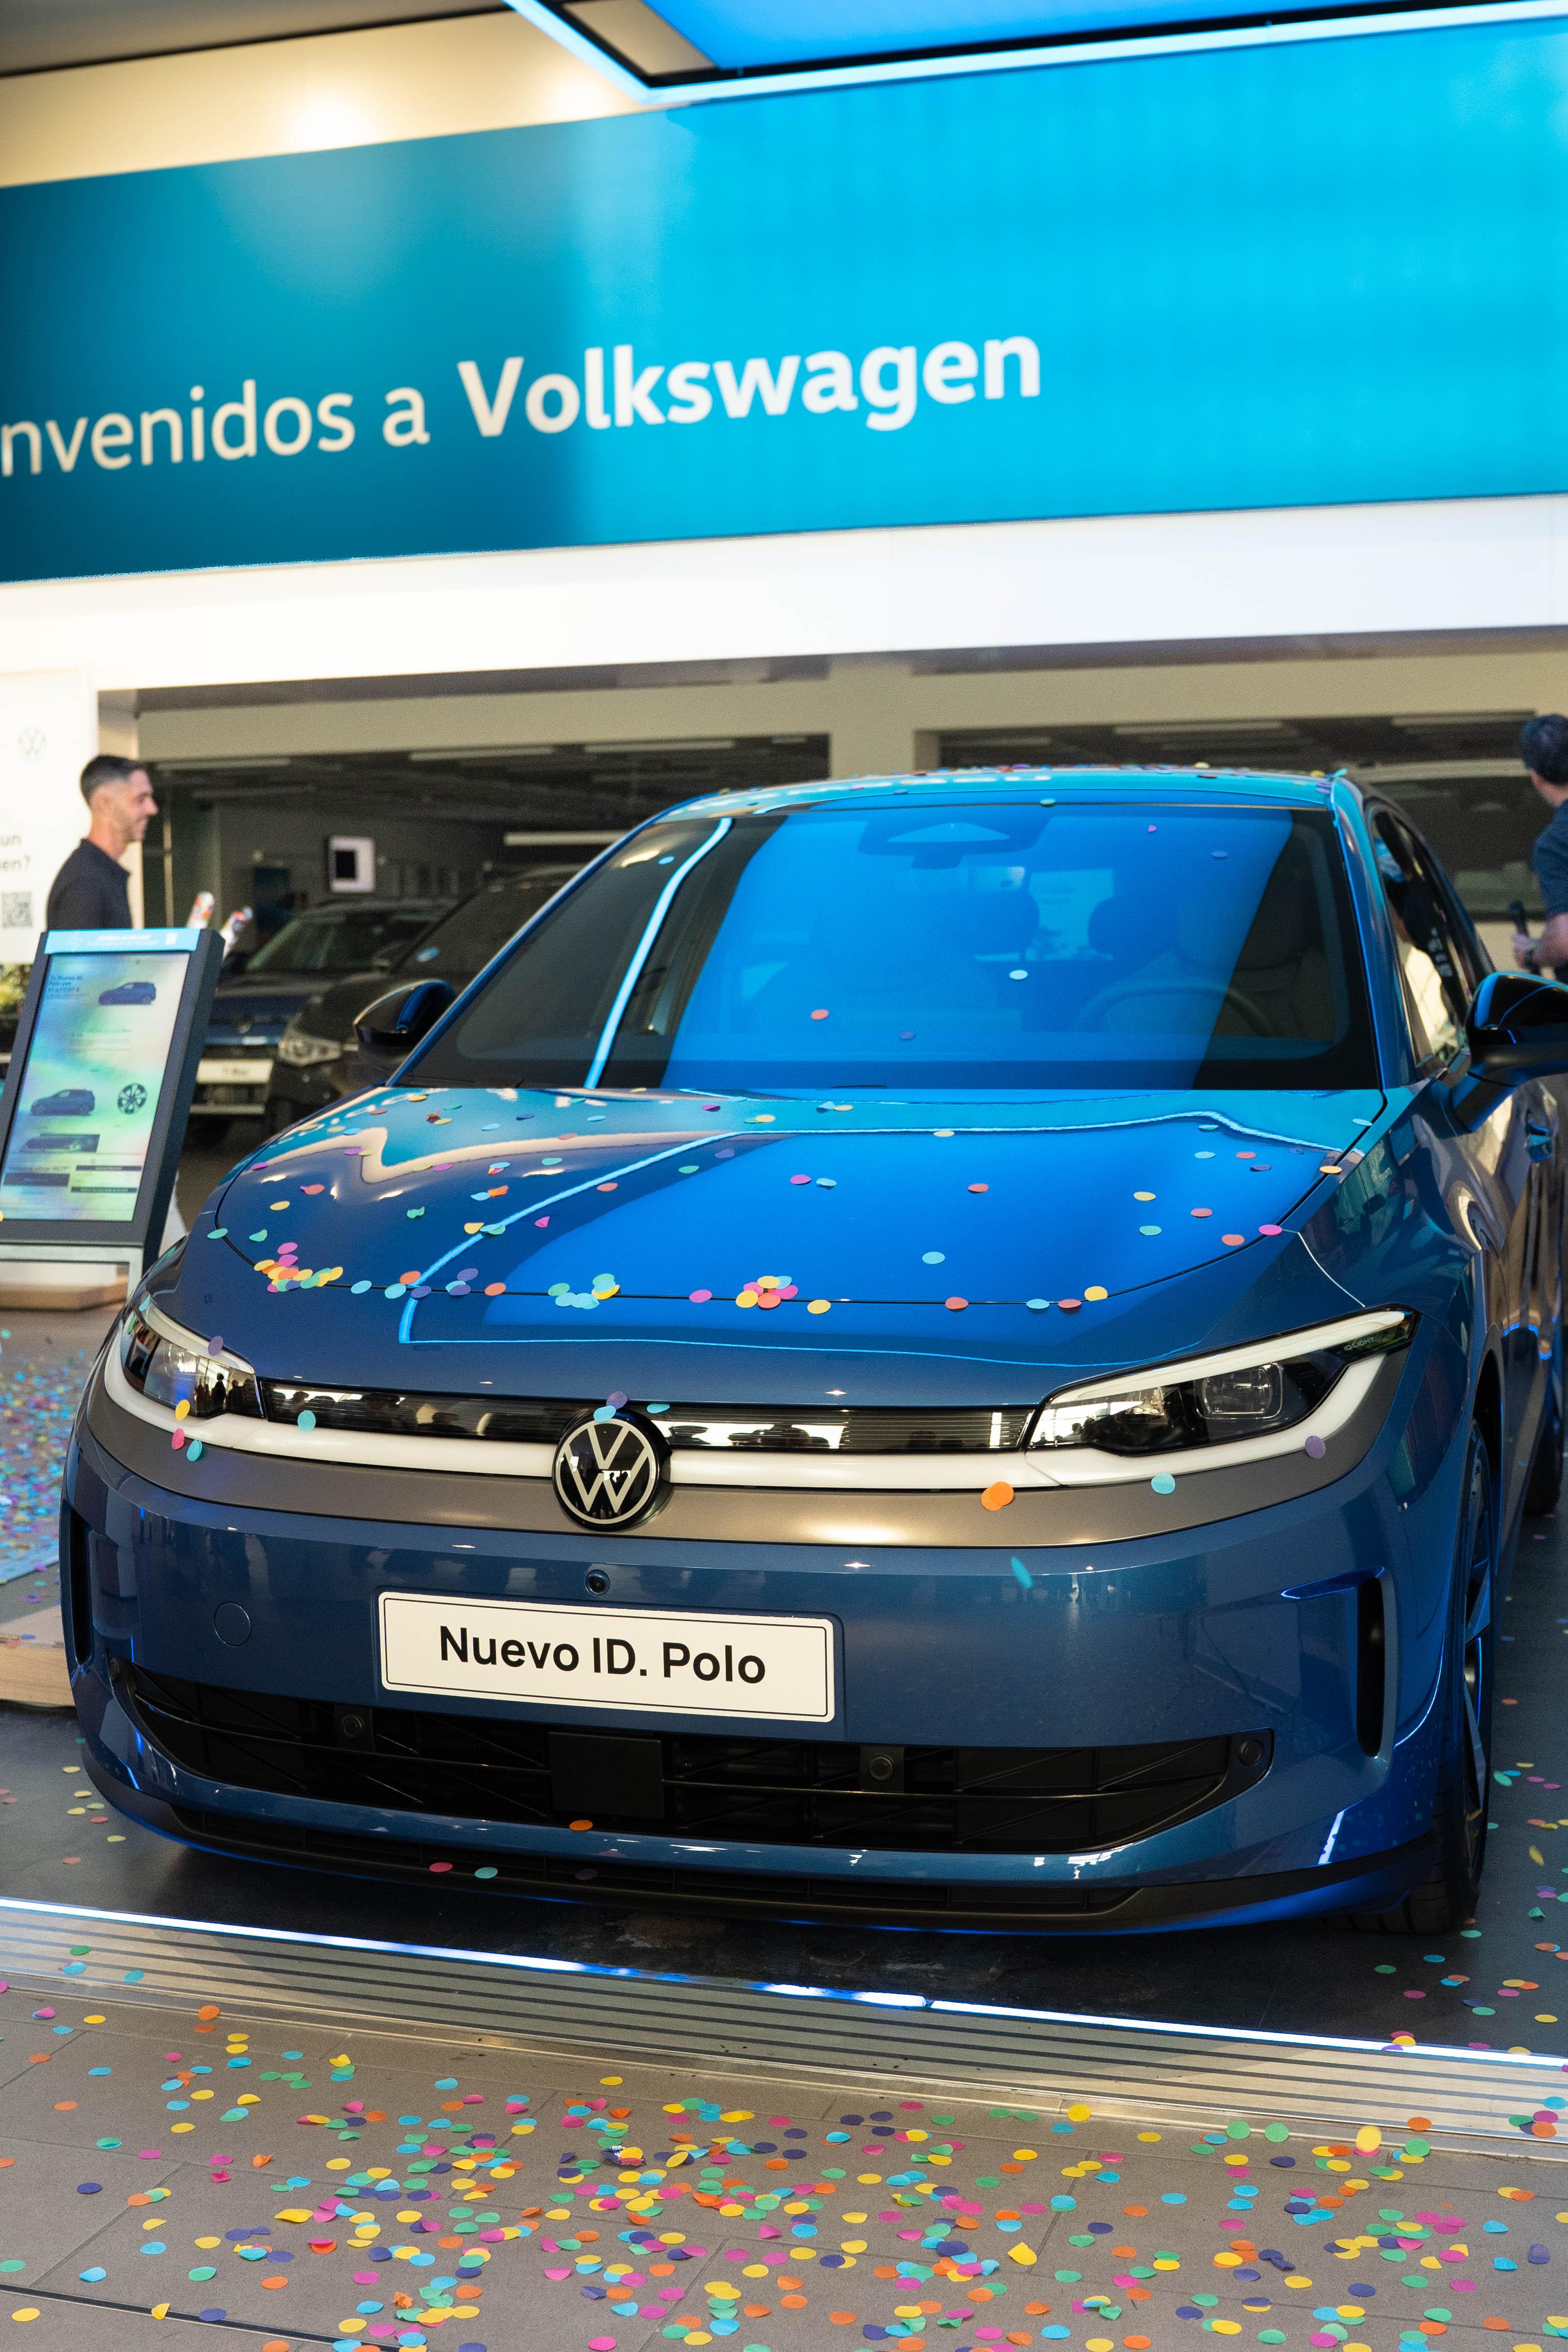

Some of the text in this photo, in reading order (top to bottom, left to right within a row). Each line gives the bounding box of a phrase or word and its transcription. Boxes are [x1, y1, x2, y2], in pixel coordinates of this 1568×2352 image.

[1, 336, 1041, 476] nvenidos a Volkswagen
[1343, 1337, 1375, 1352] IQ.LIGHT
[440, 1626, 766, 1684] Nuevo ID. Polo
